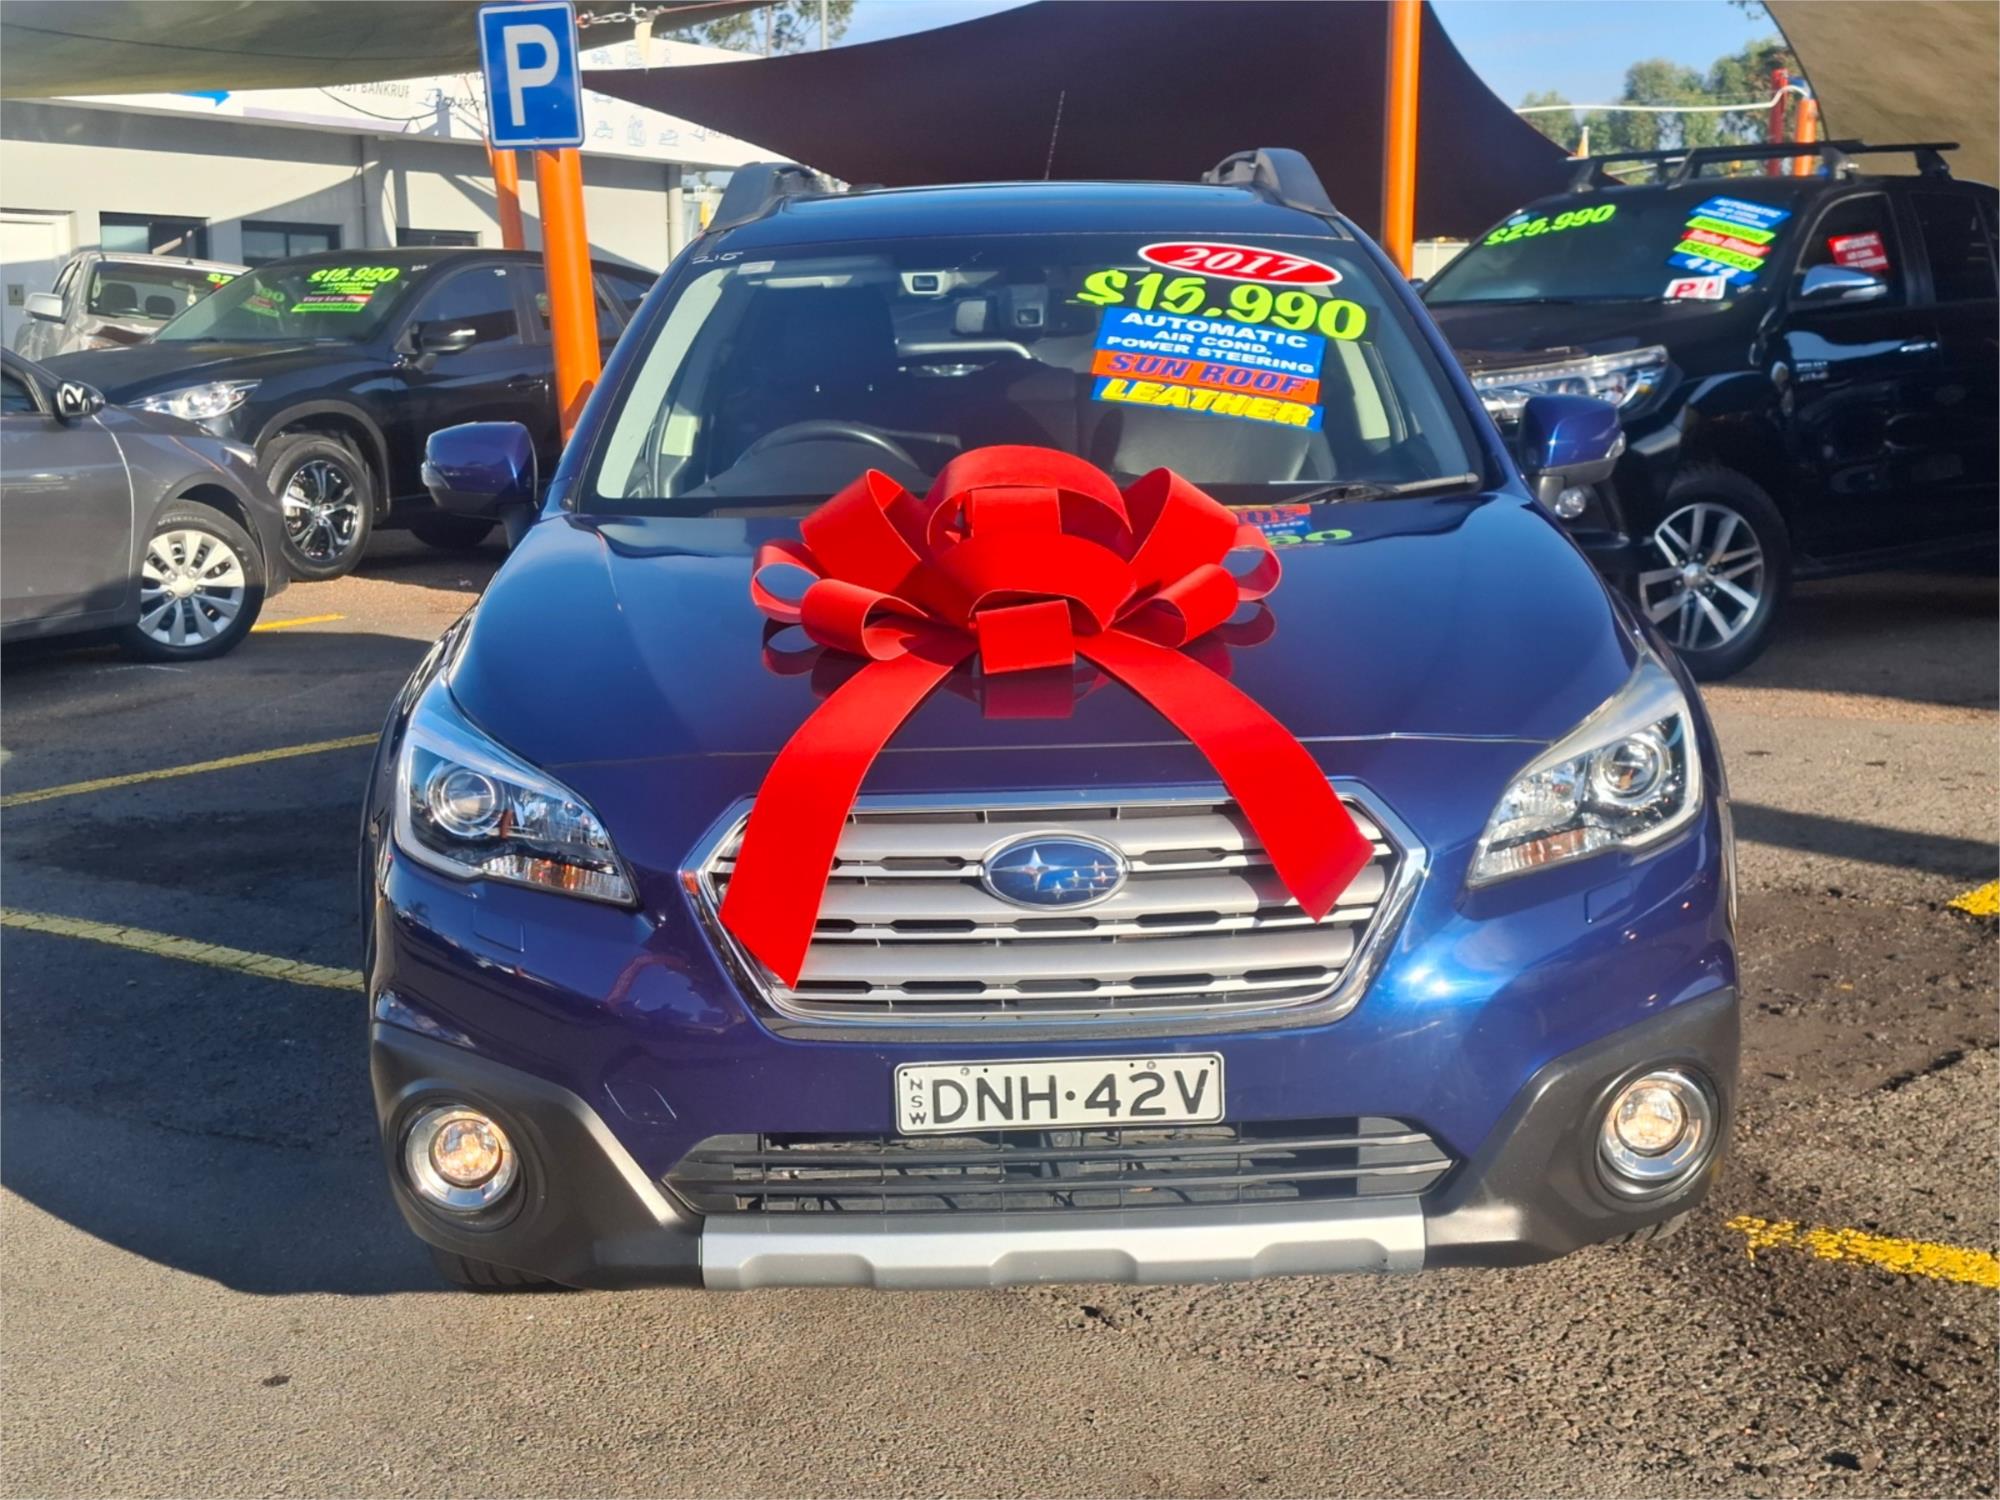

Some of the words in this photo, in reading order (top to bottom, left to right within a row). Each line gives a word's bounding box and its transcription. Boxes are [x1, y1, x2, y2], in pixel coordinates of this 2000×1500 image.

[503, 24, 560, 126] P
[1168, 247, 1311, 278] 2017
[1121, 311, 1309, 349] AUTOMATIC
[1154, 329, 1195, 344] AIR
[1201, 336, 1273, 356] COND.
[1106, 335, 1190, 355] POWER
[1196, 345, 1315, 374] STEERING
[1106, 353, 1194, 379] SUN
[1199, 363, 1311, 394] ROOF
[1101, 378, 1315, 428] LEATHER
[908, 1078, 928, 1126] NSW
